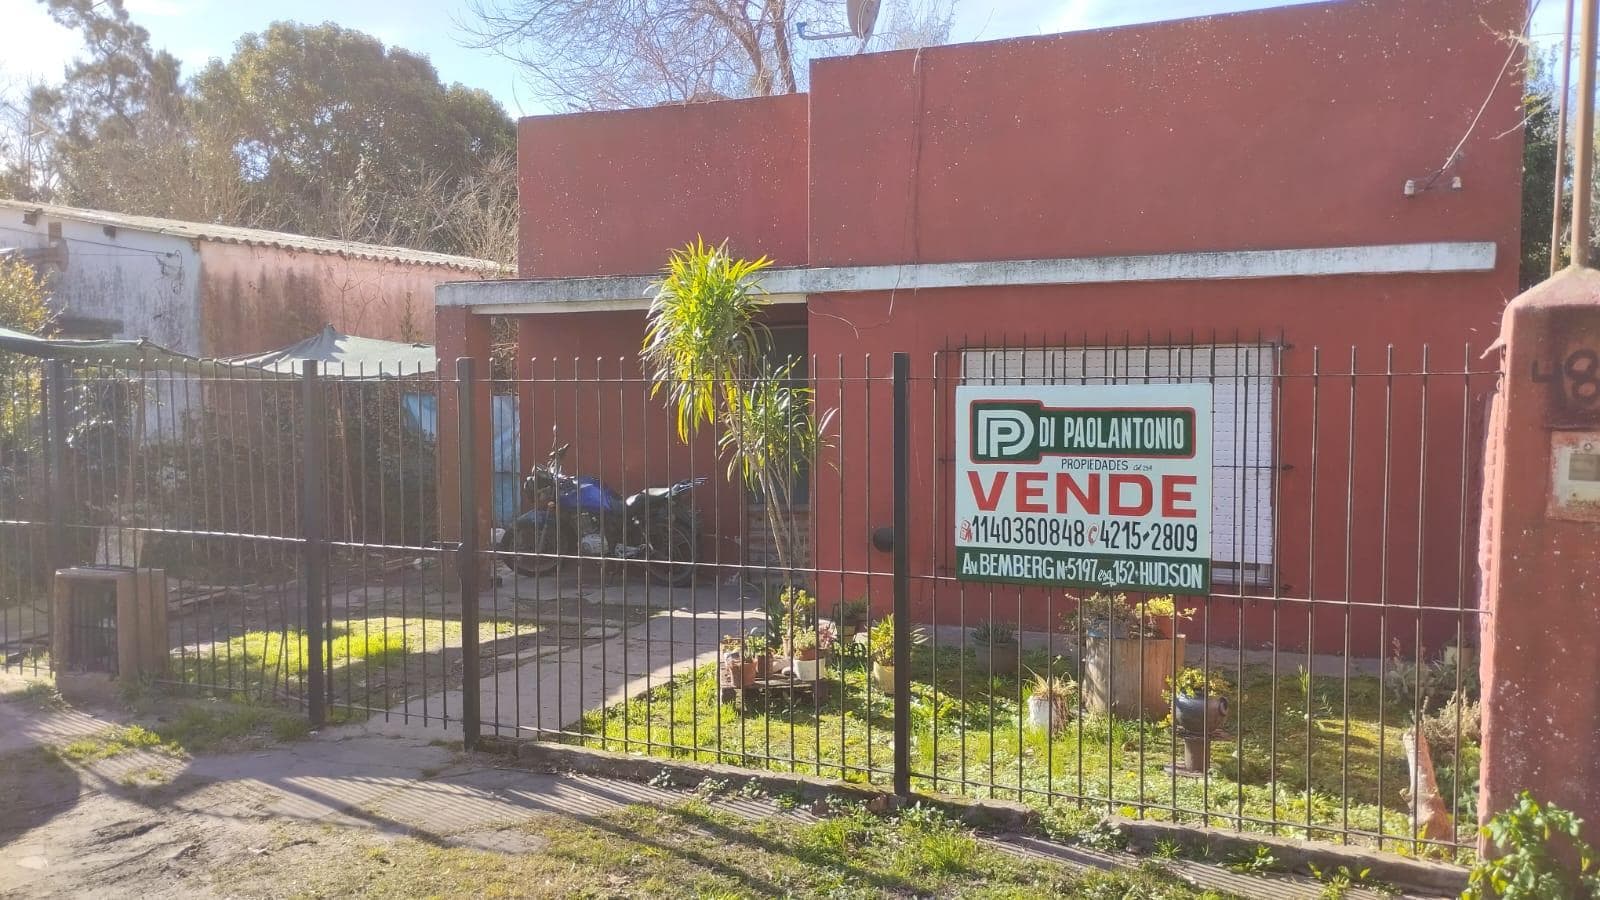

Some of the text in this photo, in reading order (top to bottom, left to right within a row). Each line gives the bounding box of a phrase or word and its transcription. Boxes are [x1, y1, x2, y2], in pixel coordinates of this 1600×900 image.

[1039, 416, 1185, 450] DI PAOLANTONIO
[1061, 458, 1129, 471] PROPIEDADES
[967, 471, 1197, 518] VENDE
[972, 515, 1085, 546] 1140360848
[980, 553, 1055, 580] BEMBERG
[1067, 558, 1098, 582] 5197
[1113, 560, 1135, 585] 152
[1140, 561, 1203, 589] HUDSON
